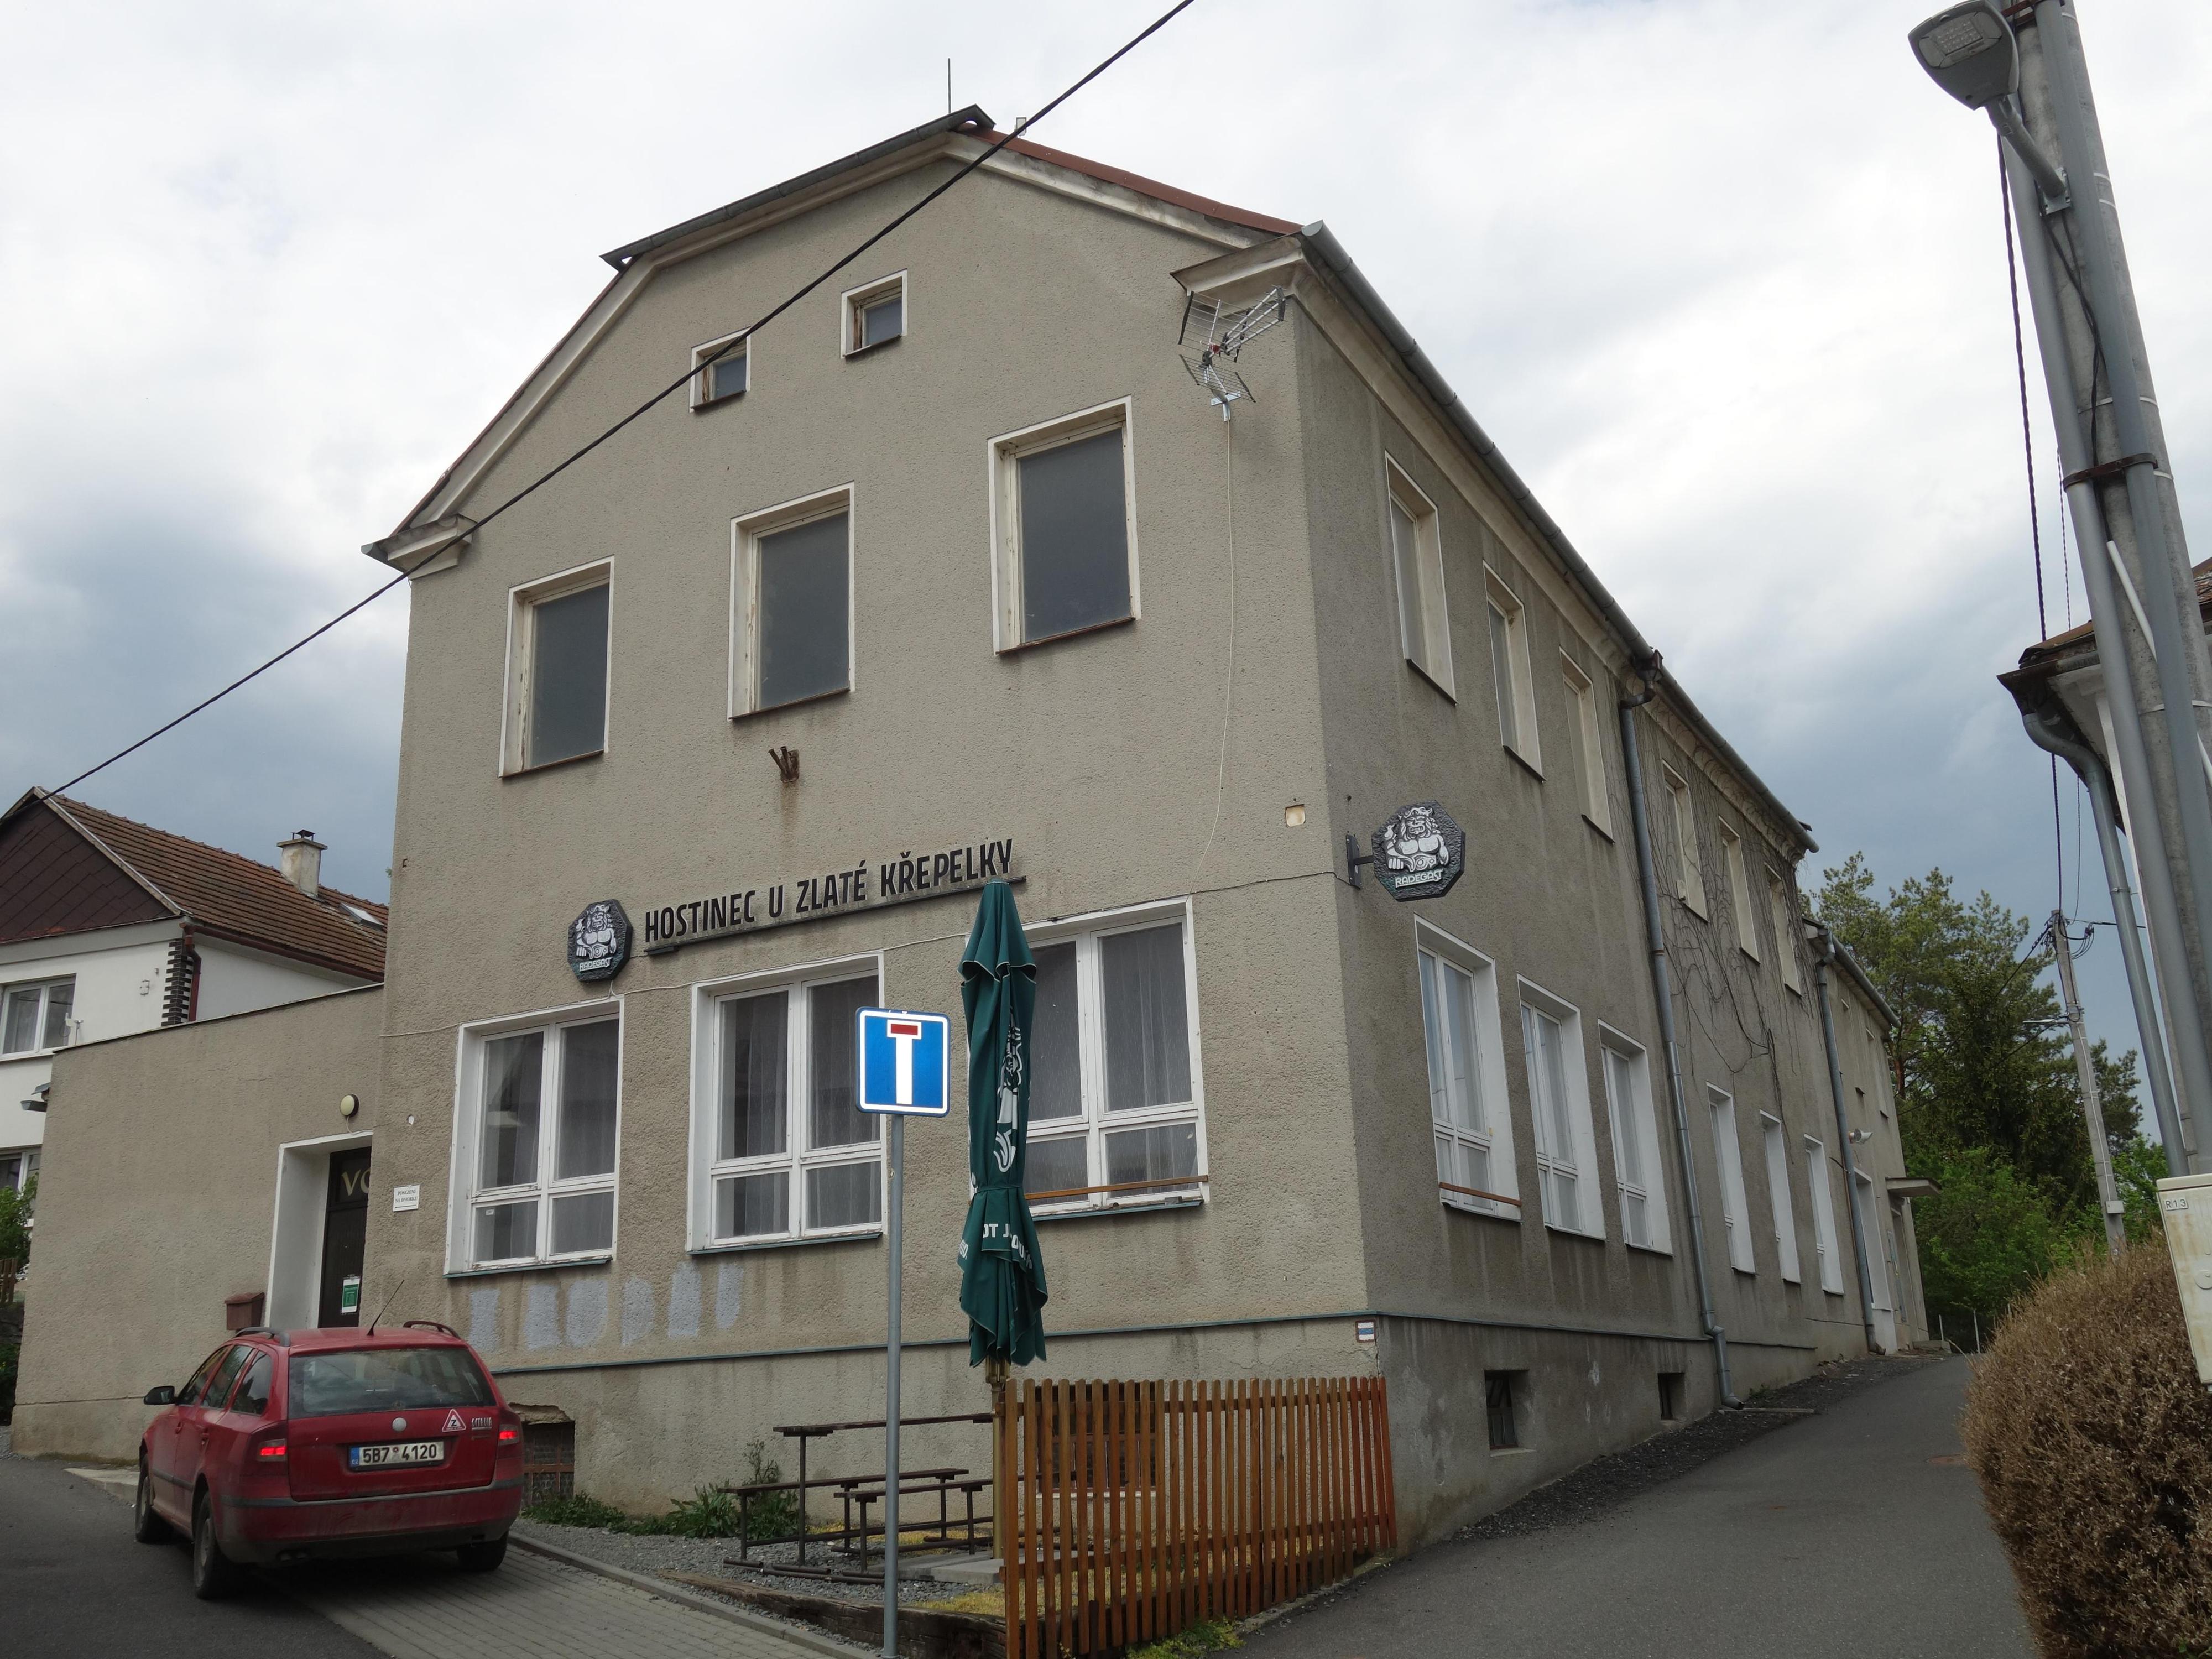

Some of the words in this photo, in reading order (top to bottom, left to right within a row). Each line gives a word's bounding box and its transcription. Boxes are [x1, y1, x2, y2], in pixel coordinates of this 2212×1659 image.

[1395, 869, 1444, 888] RADEGAST
[645, 890, 756, 942] HOSTINEC
[769, 885, 784, 918] U
[796, 860, 867, 913] ZLATÉ
[881, 838, 1013, 896] KŘEPELKY
[579, 956, 613, 972] RADEGAST
[2166, 1199, 2186, 1208] R13
[363, 1446, 390, 1463] 5B7
[402, 1444, 437, 1460] 4120
